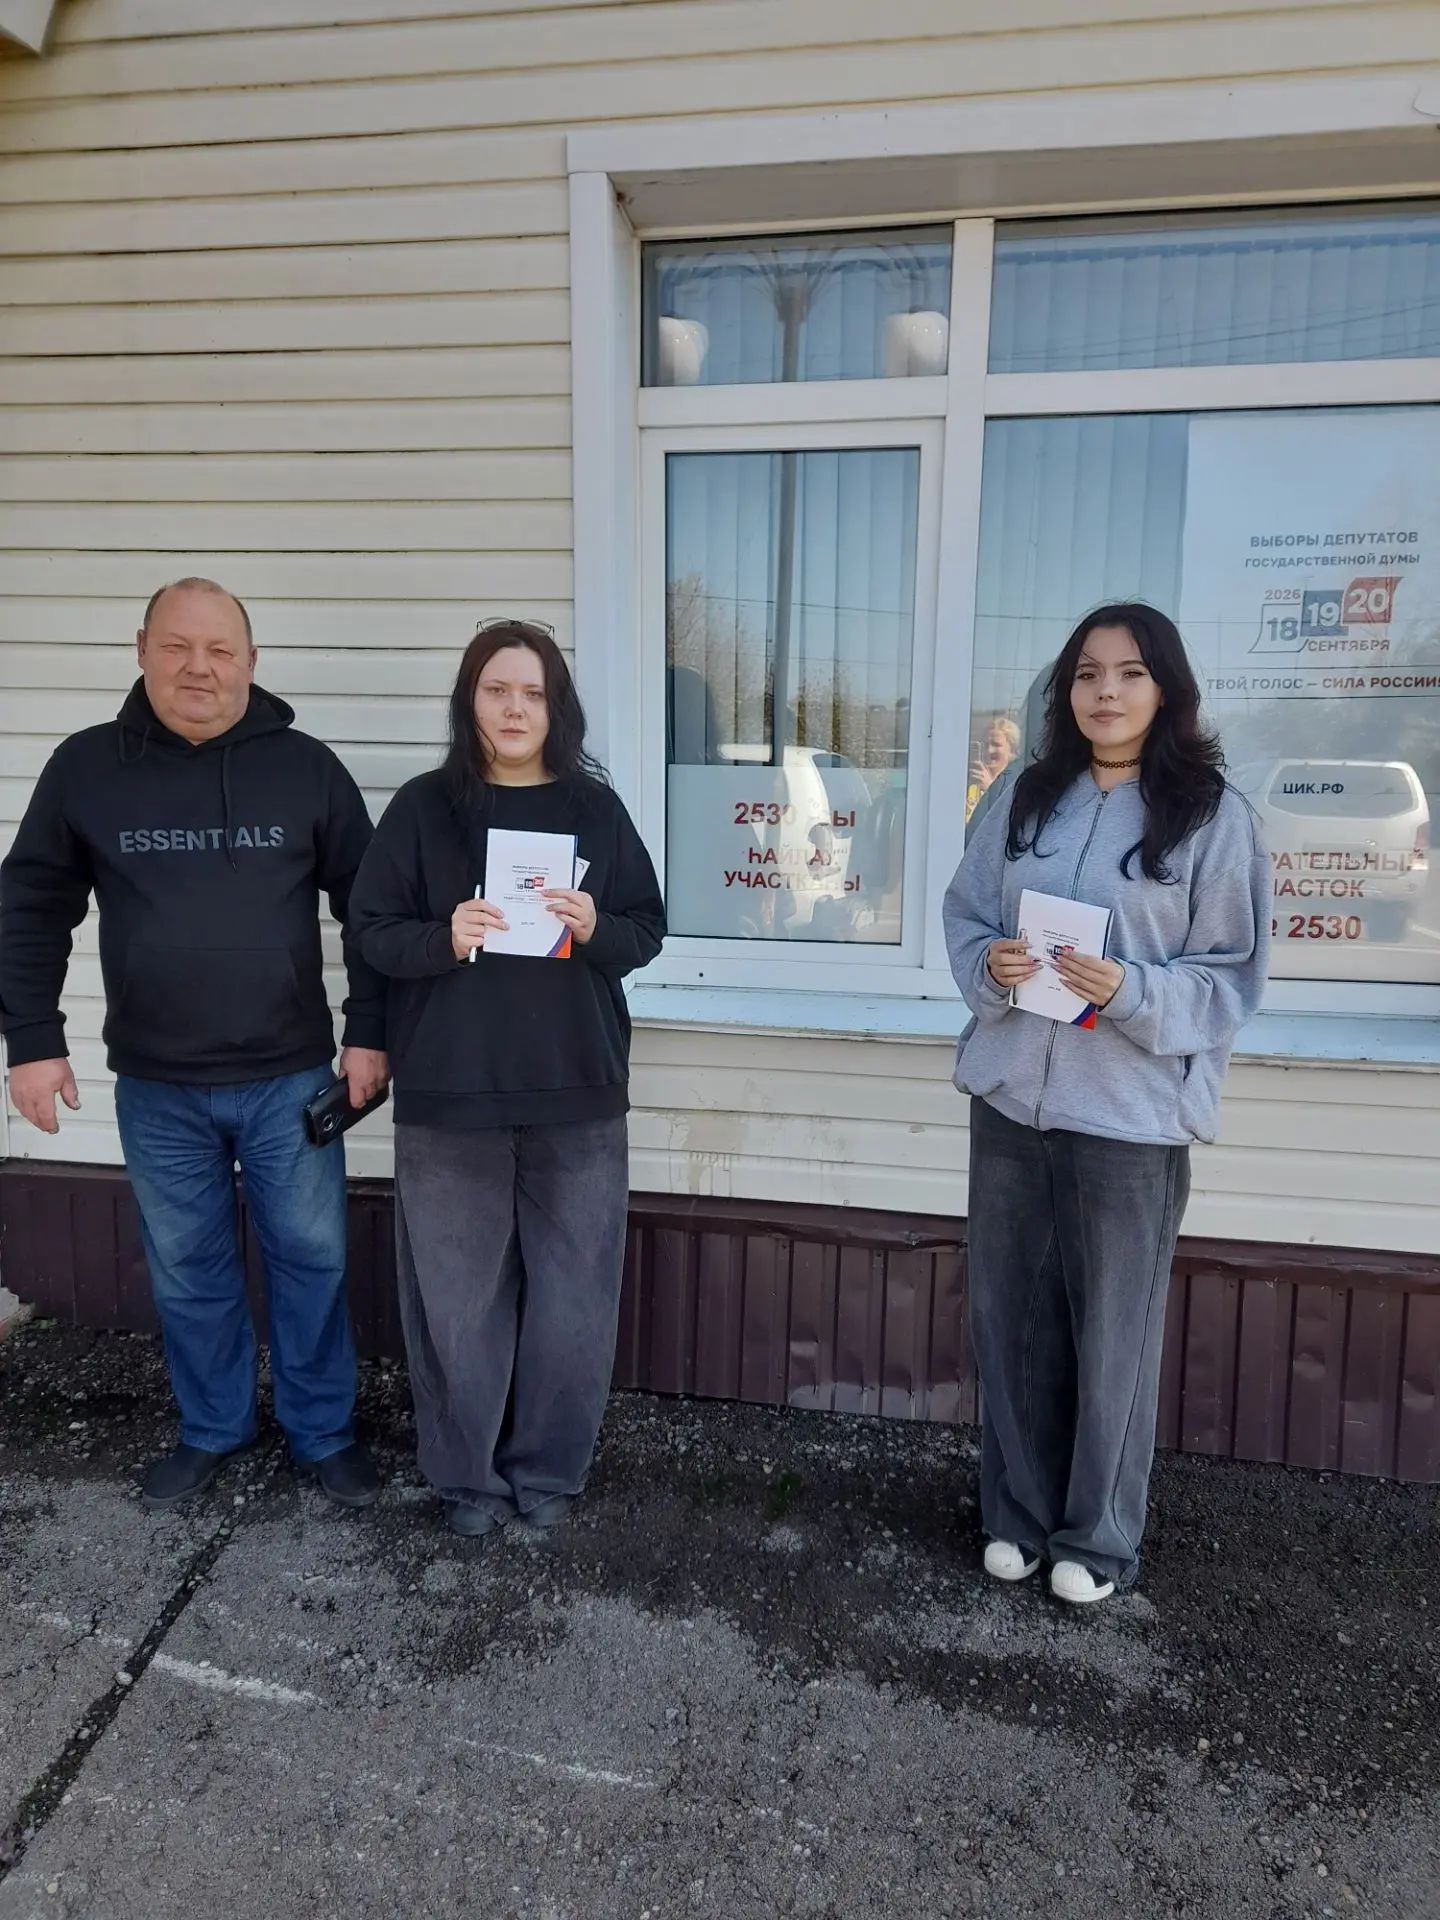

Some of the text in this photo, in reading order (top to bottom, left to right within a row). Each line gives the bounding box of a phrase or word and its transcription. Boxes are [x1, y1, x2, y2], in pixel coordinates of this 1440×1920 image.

[1250, 531, 1419, 548] ВЫБОРЫ ДЕПУТАТОВ
[1245, 553, 1420, 568] ГОСУДАРСТВЕННОЙ ДУМЫ
[1264, 588, 1301, 601] 2026
[1266, 588, 1390, 641] 18 19 20
[1308, 639, 1390, 652] СЕНТЯБРЯ
[1207, 675, 1248, 690] ТВОЙ
[1252, 678, 1304, 690] ГОЛОС
[1322, 677, 1365, 690] СИЛА
[1283, 782, 1344, 795] ЦИК.РФ
[1287, 914, 1362, 940] 2530
